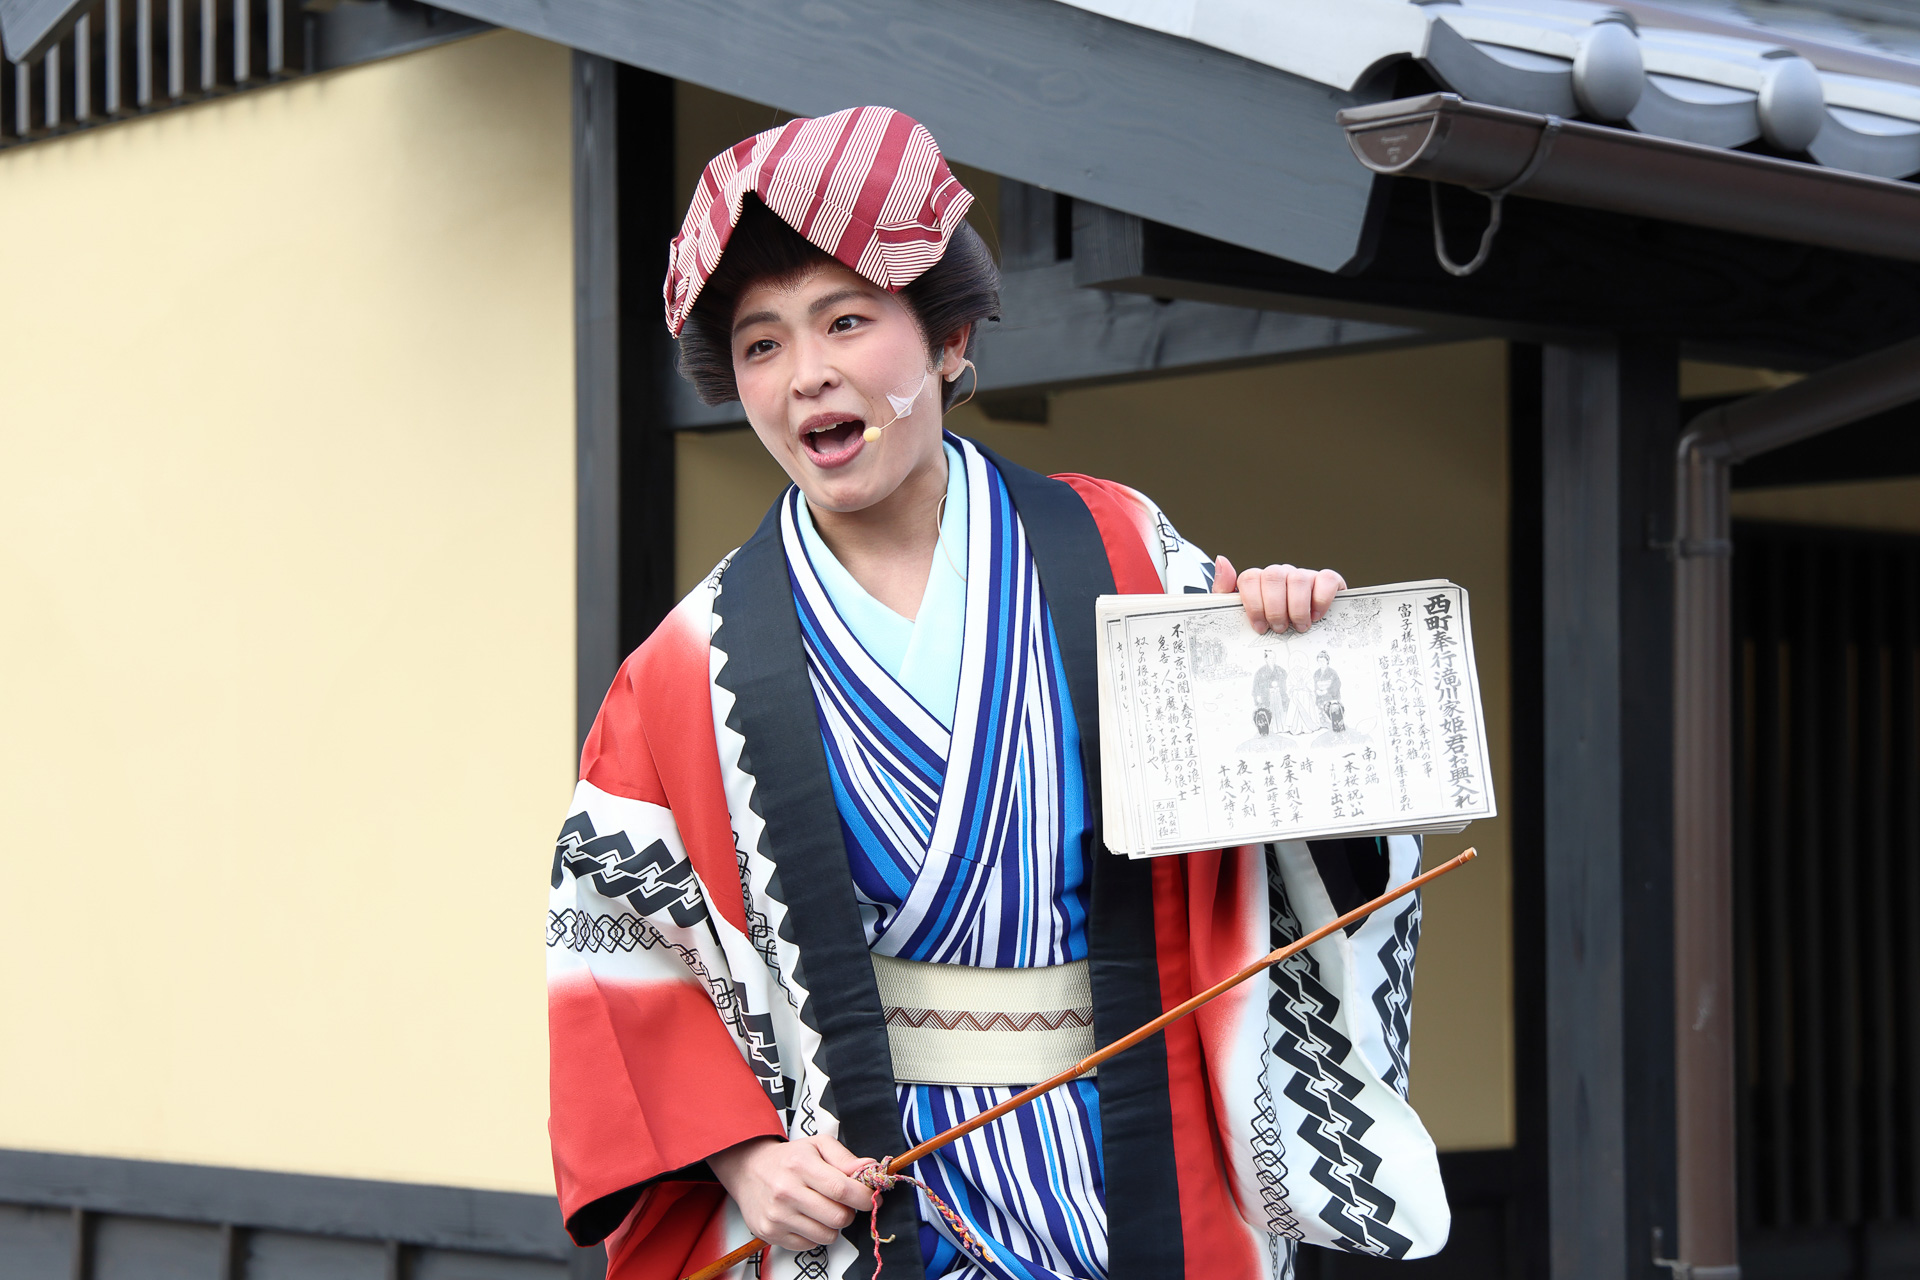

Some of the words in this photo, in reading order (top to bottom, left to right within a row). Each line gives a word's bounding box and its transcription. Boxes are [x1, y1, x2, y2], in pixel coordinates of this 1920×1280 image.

[1300, 757, 1314, 773] 時
[1362, 746, 1379, 785] 南の端
[1402, 722, 1419, 760] 京の雅
[1218, 764, 1237, 829] 午後八時より
[1263, 761, 1282, 827] 午後一時三十分
[1329, 763, 1345, 818] よりご出立
[1342, 752, 1364, 817] 一本桜祝い山
